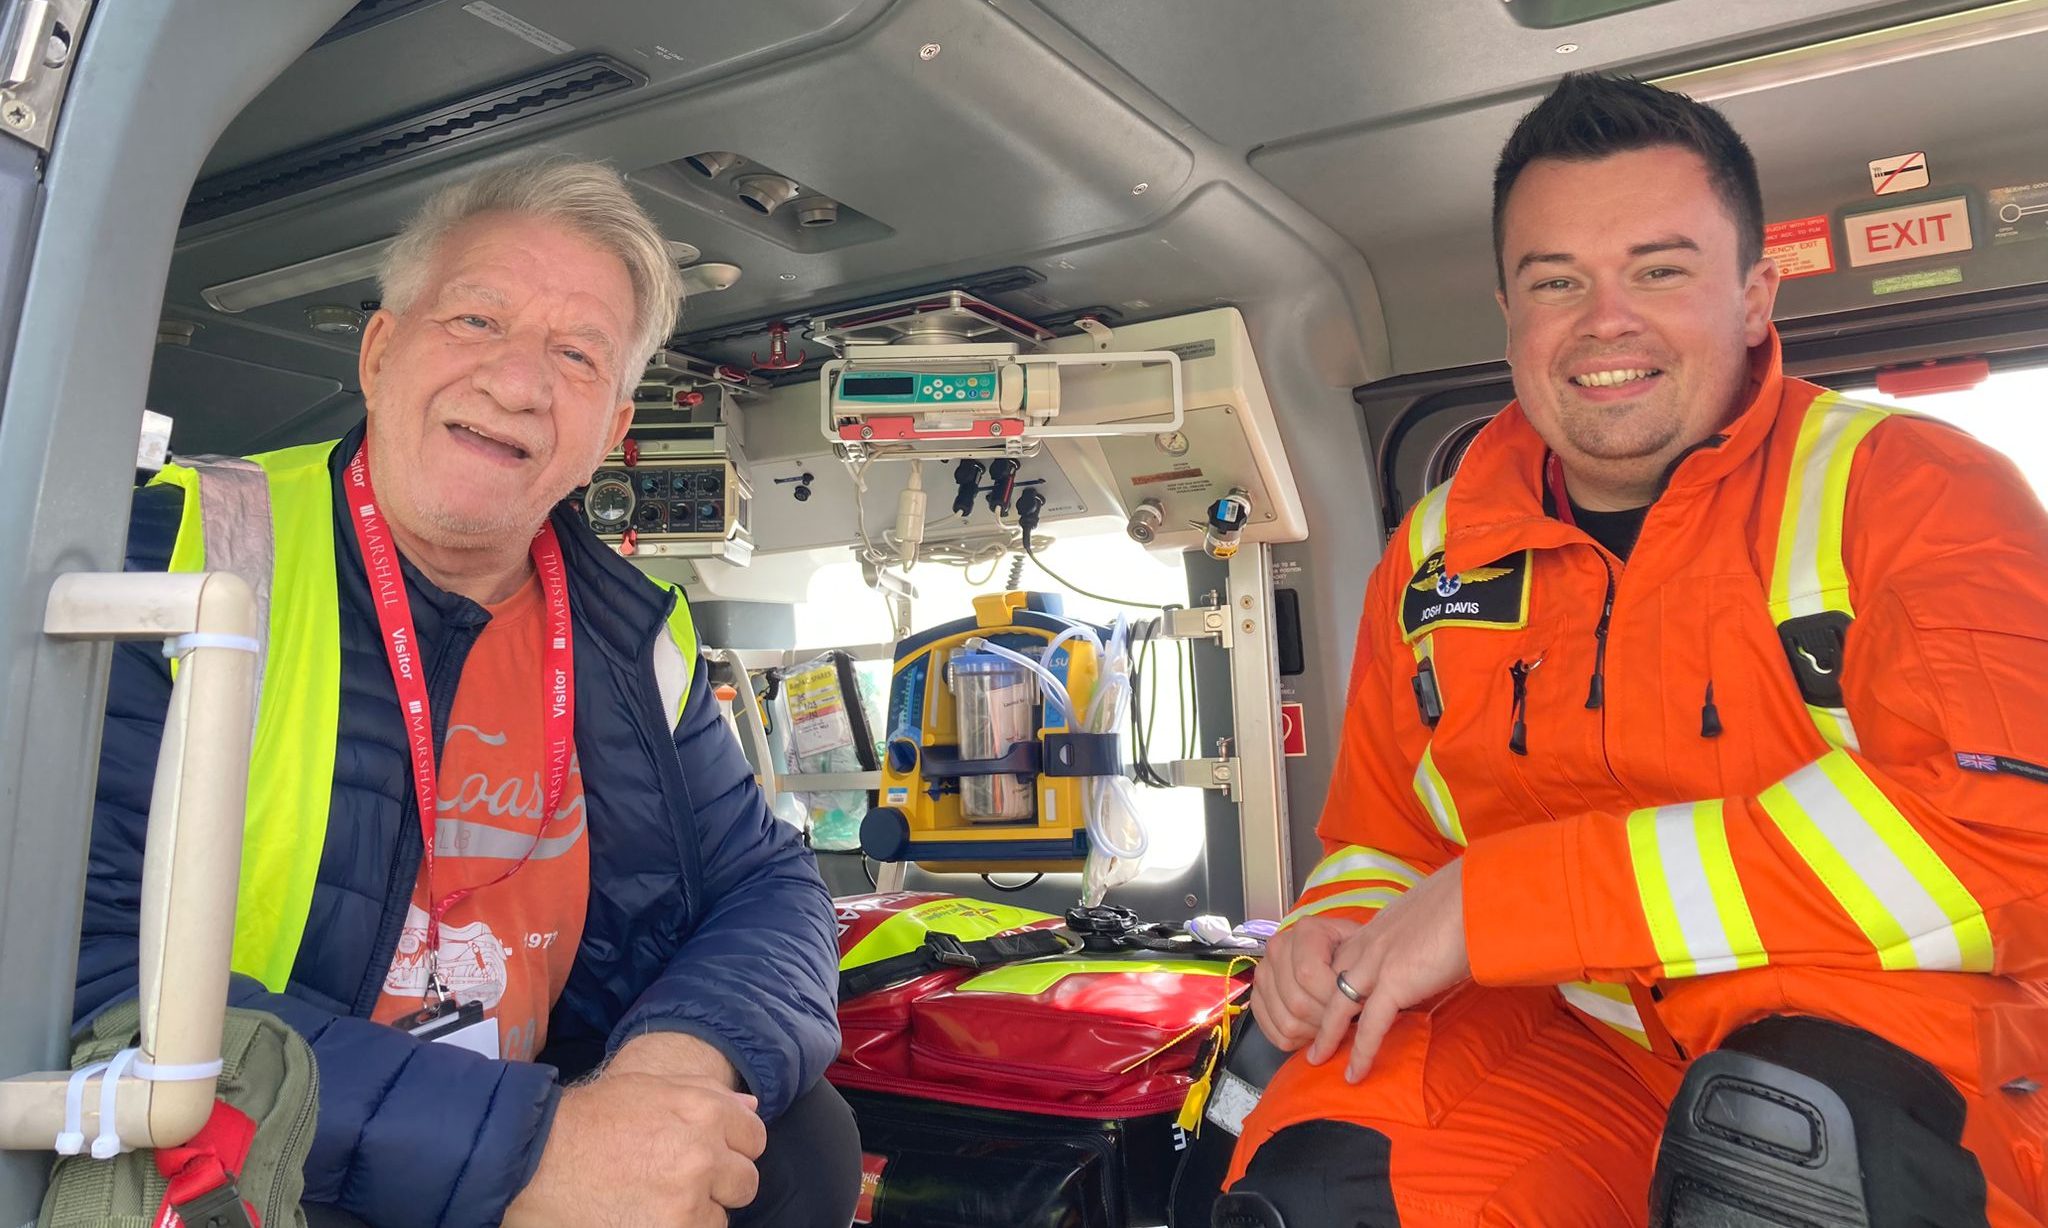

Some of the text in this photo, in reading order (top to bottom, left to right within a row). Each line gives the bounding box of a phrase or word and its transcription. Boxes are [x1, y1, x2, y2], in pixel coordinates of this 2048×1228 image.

[1807, 218, 1825, 226] OPEN
[1865, 213, 1952, 253] EXIT
[1764, 240, 1818, 255] GENCY EXIT
[362, 517, 399, 609] MARSHALL
[549, 549, 567, 635] MARSHALL
[1420, 602, 1480, 621] JOSH DAVIS
[391, 628, 413, 681] Visitor
[1049, 657, 1069, 668] LSU
[553, 668, 566, 719] Visitor
[410, 714, 432, 815] MARSHALL
